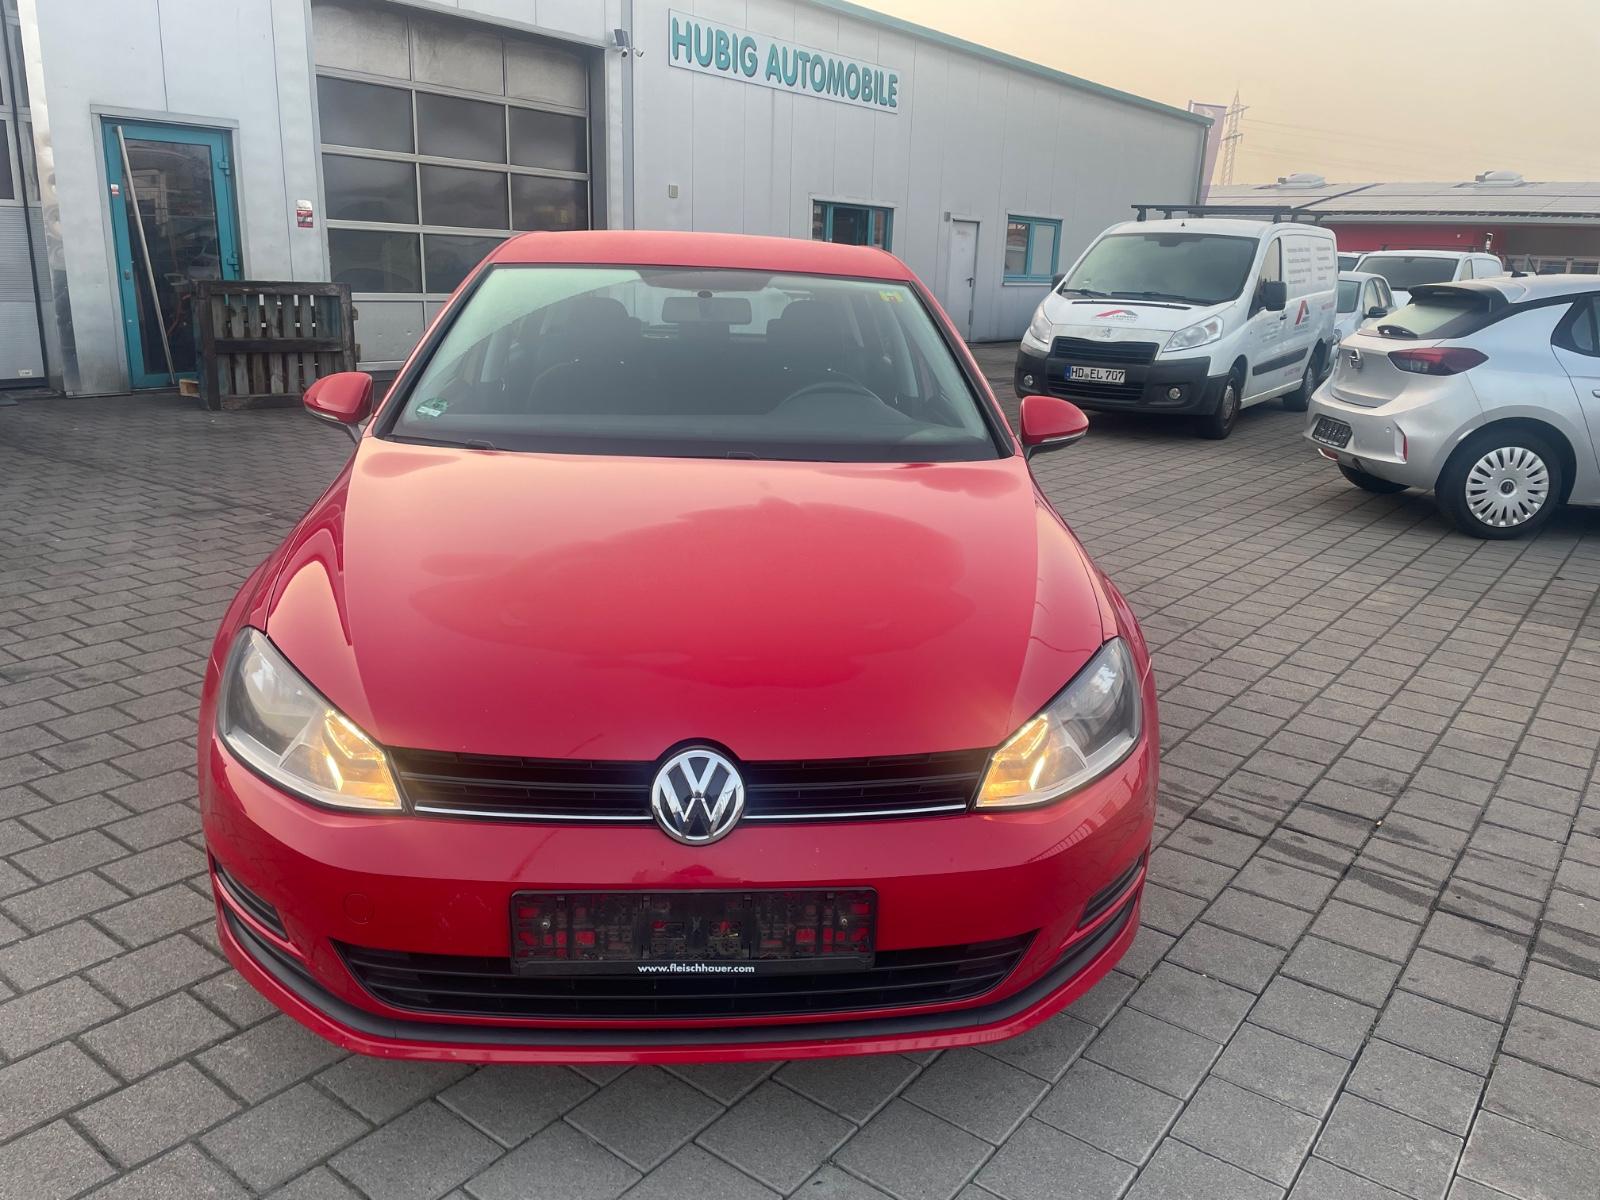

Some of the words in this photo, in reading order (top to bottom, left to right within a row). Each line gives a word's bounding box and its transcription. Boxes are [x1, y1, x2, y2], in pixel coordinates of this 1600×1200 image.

[671, 17, 758, 77] HUBIG
[765, 43, 898, 108] AUTOMOBILE
[1071, 367, 1085, 378] HD
[1090, 369, 1103, 380] EL
[1105, 370, 1124, 382] 707
[637, 963, 755, 974] www.fleischhauer.com
